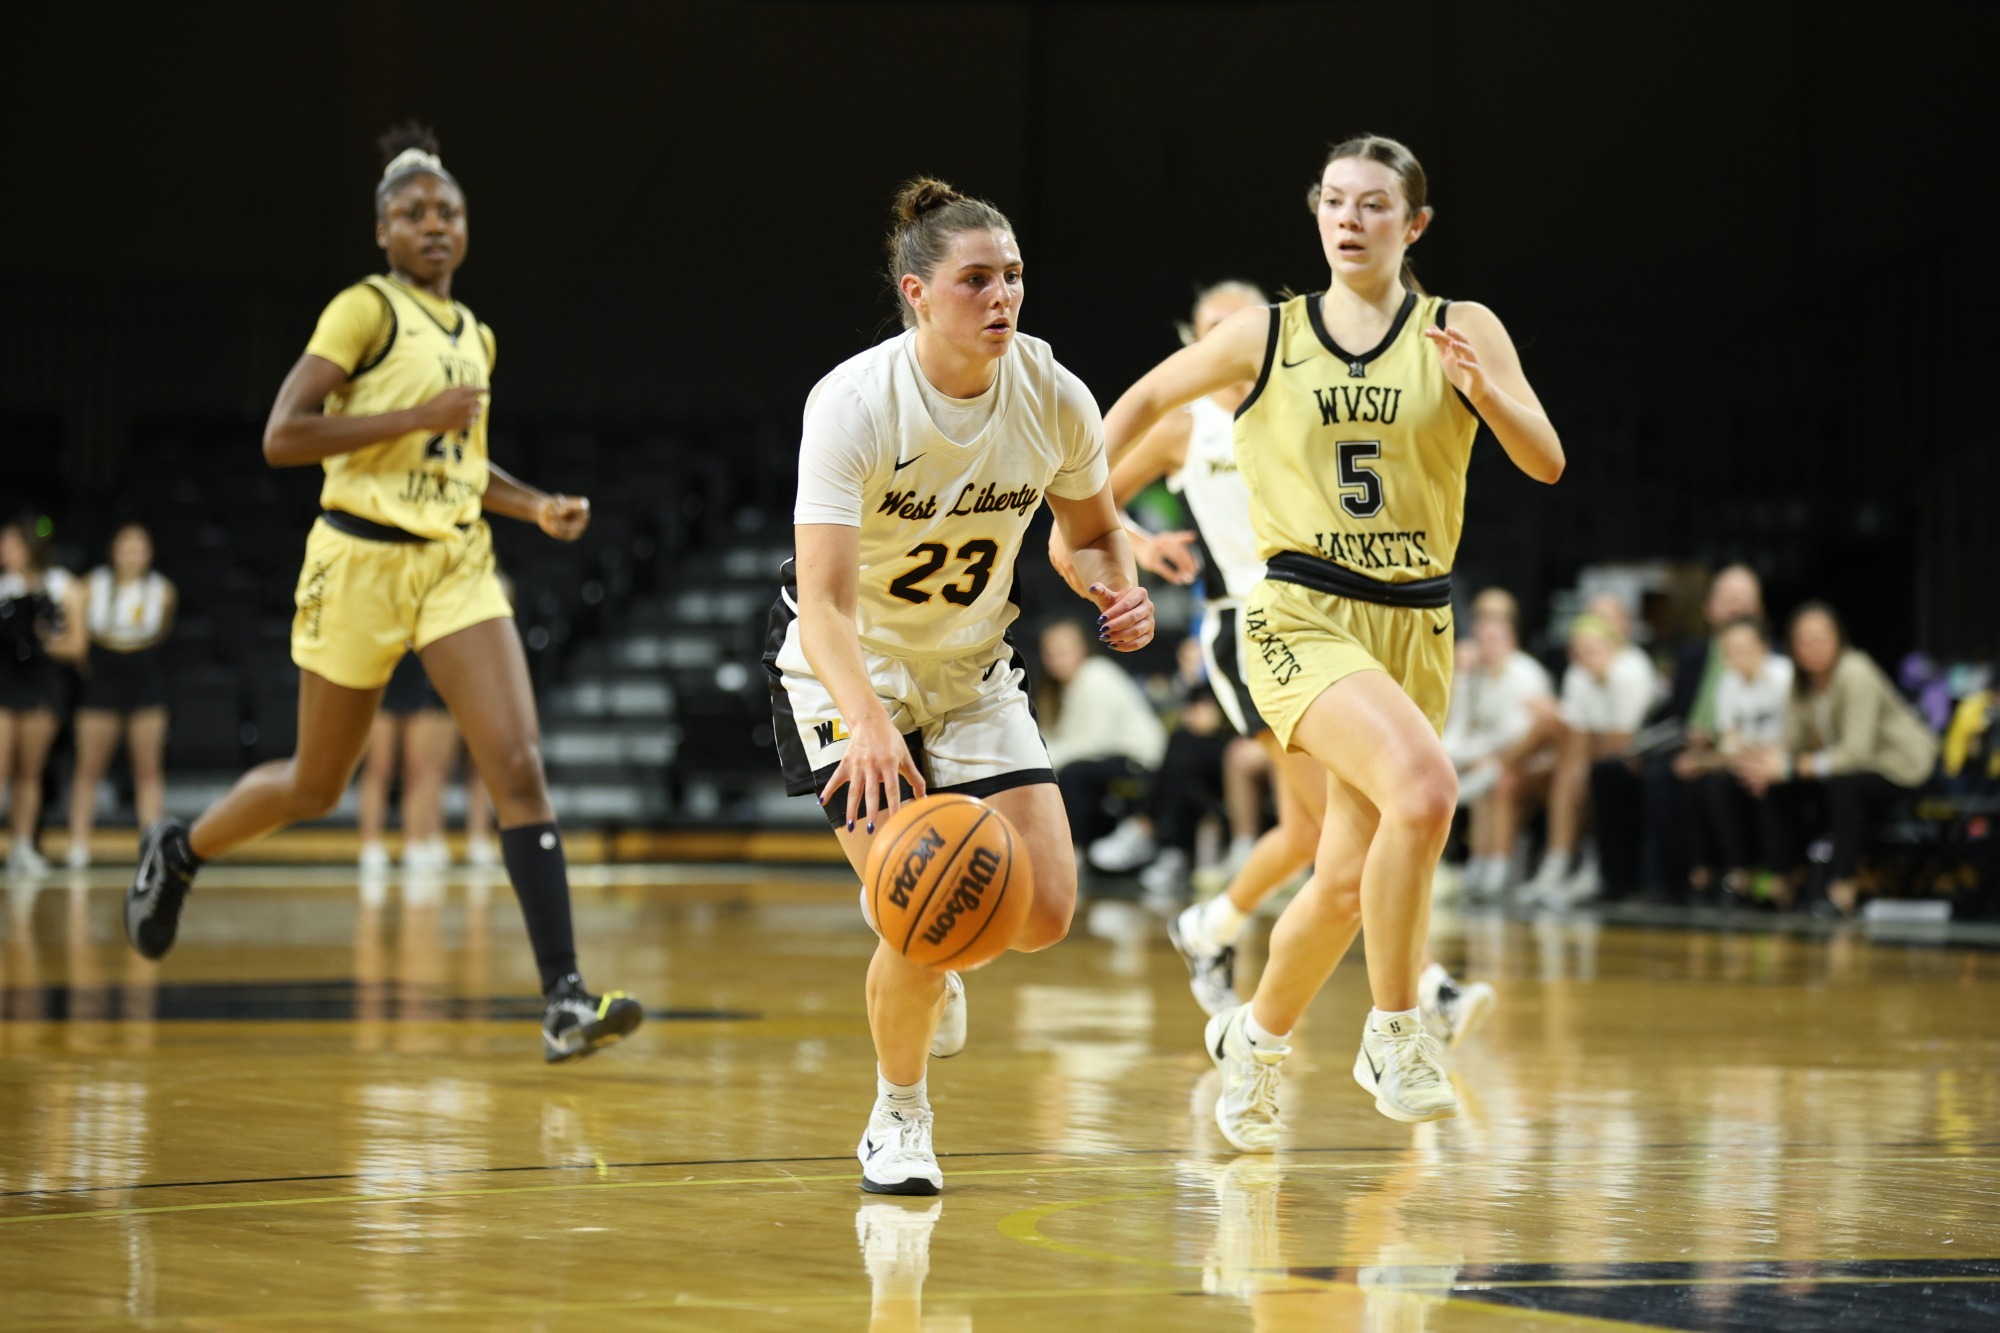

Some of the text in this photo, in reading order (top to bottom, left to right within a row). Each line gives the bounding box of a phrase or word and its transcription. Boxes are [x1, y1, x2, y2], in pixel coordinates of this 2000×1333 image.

[1313, 386, 1402, 426] WVSU
[876, 482, 1038, 520] West Liberty
[1335, 440, 1384, 518] 5
[888, 537, 999, 608] 23
[889, 826, 946, 911] NCAA
[922, 847, 1002, 946] Wilson
